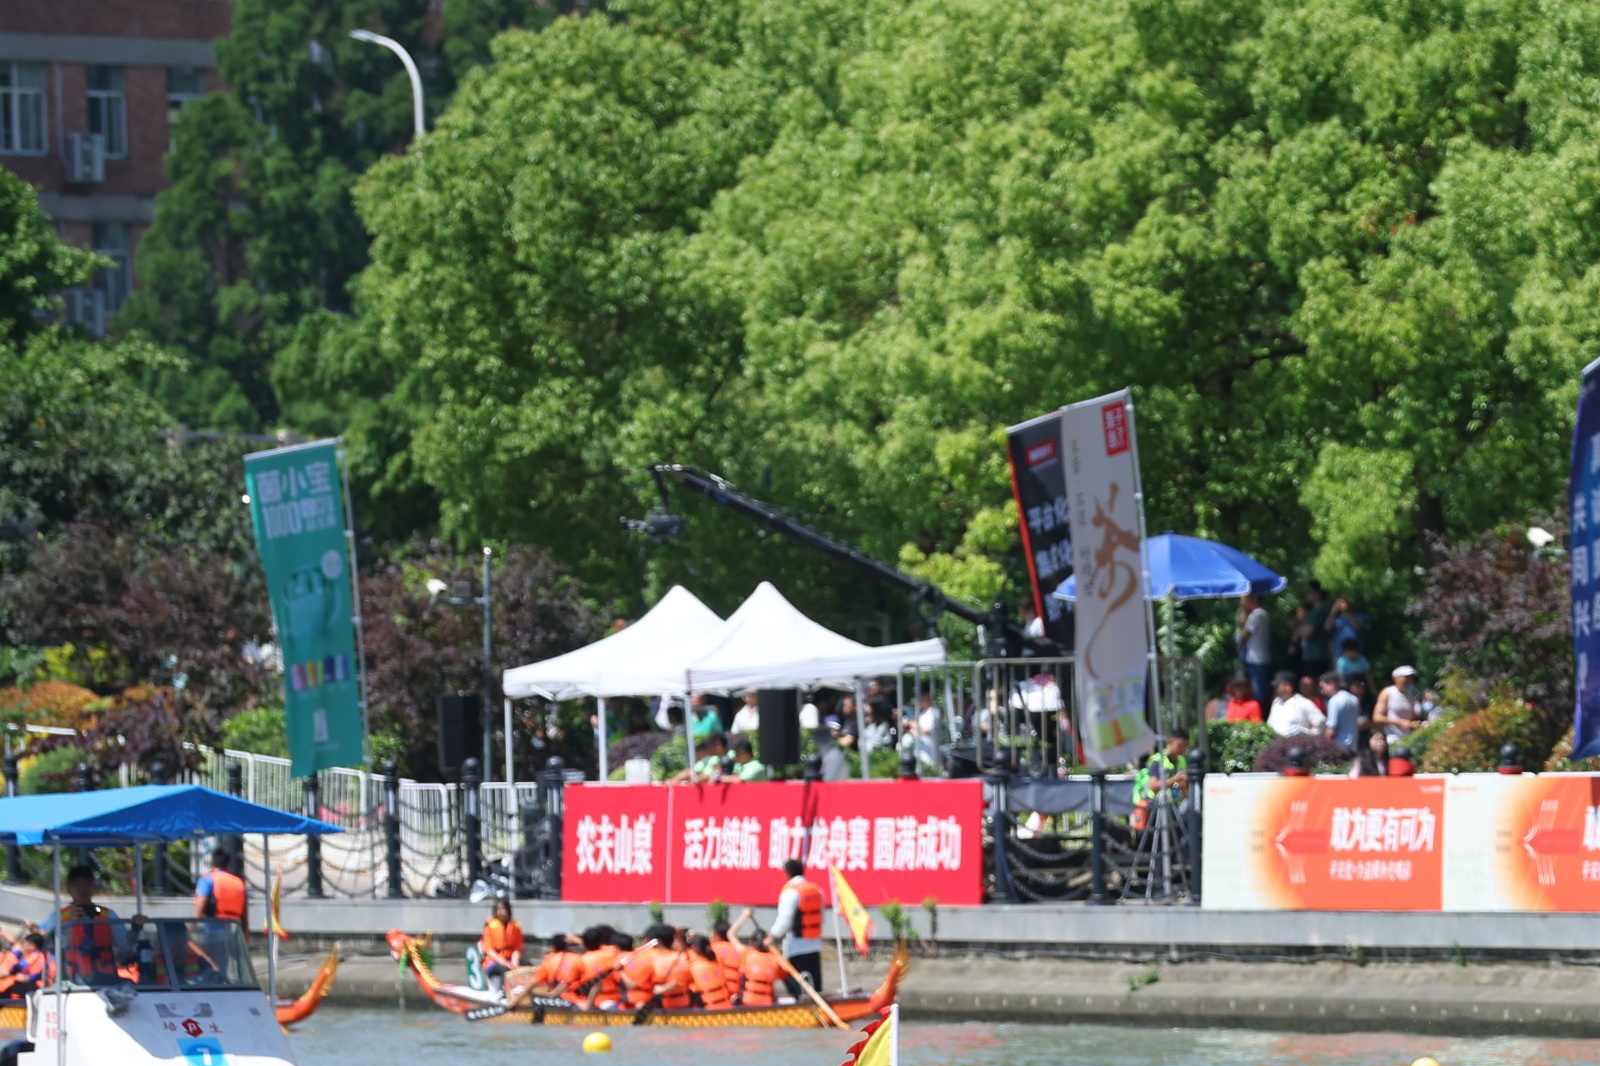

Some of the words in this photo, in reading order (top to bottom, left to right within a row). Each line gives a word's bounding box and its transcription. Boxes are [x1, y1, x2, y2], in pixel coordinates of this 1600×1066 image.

[257, 461, 332, 504] 菌小宝
[576, 815, 652, 874] 农夫山泉
[684, 816, 761, 869] 活力续航
[873, 815, 962, 871] 圆满成功
[1330, 806, 1436, 852] 敢为更有可为
[465, 946, 484, 991] 3
